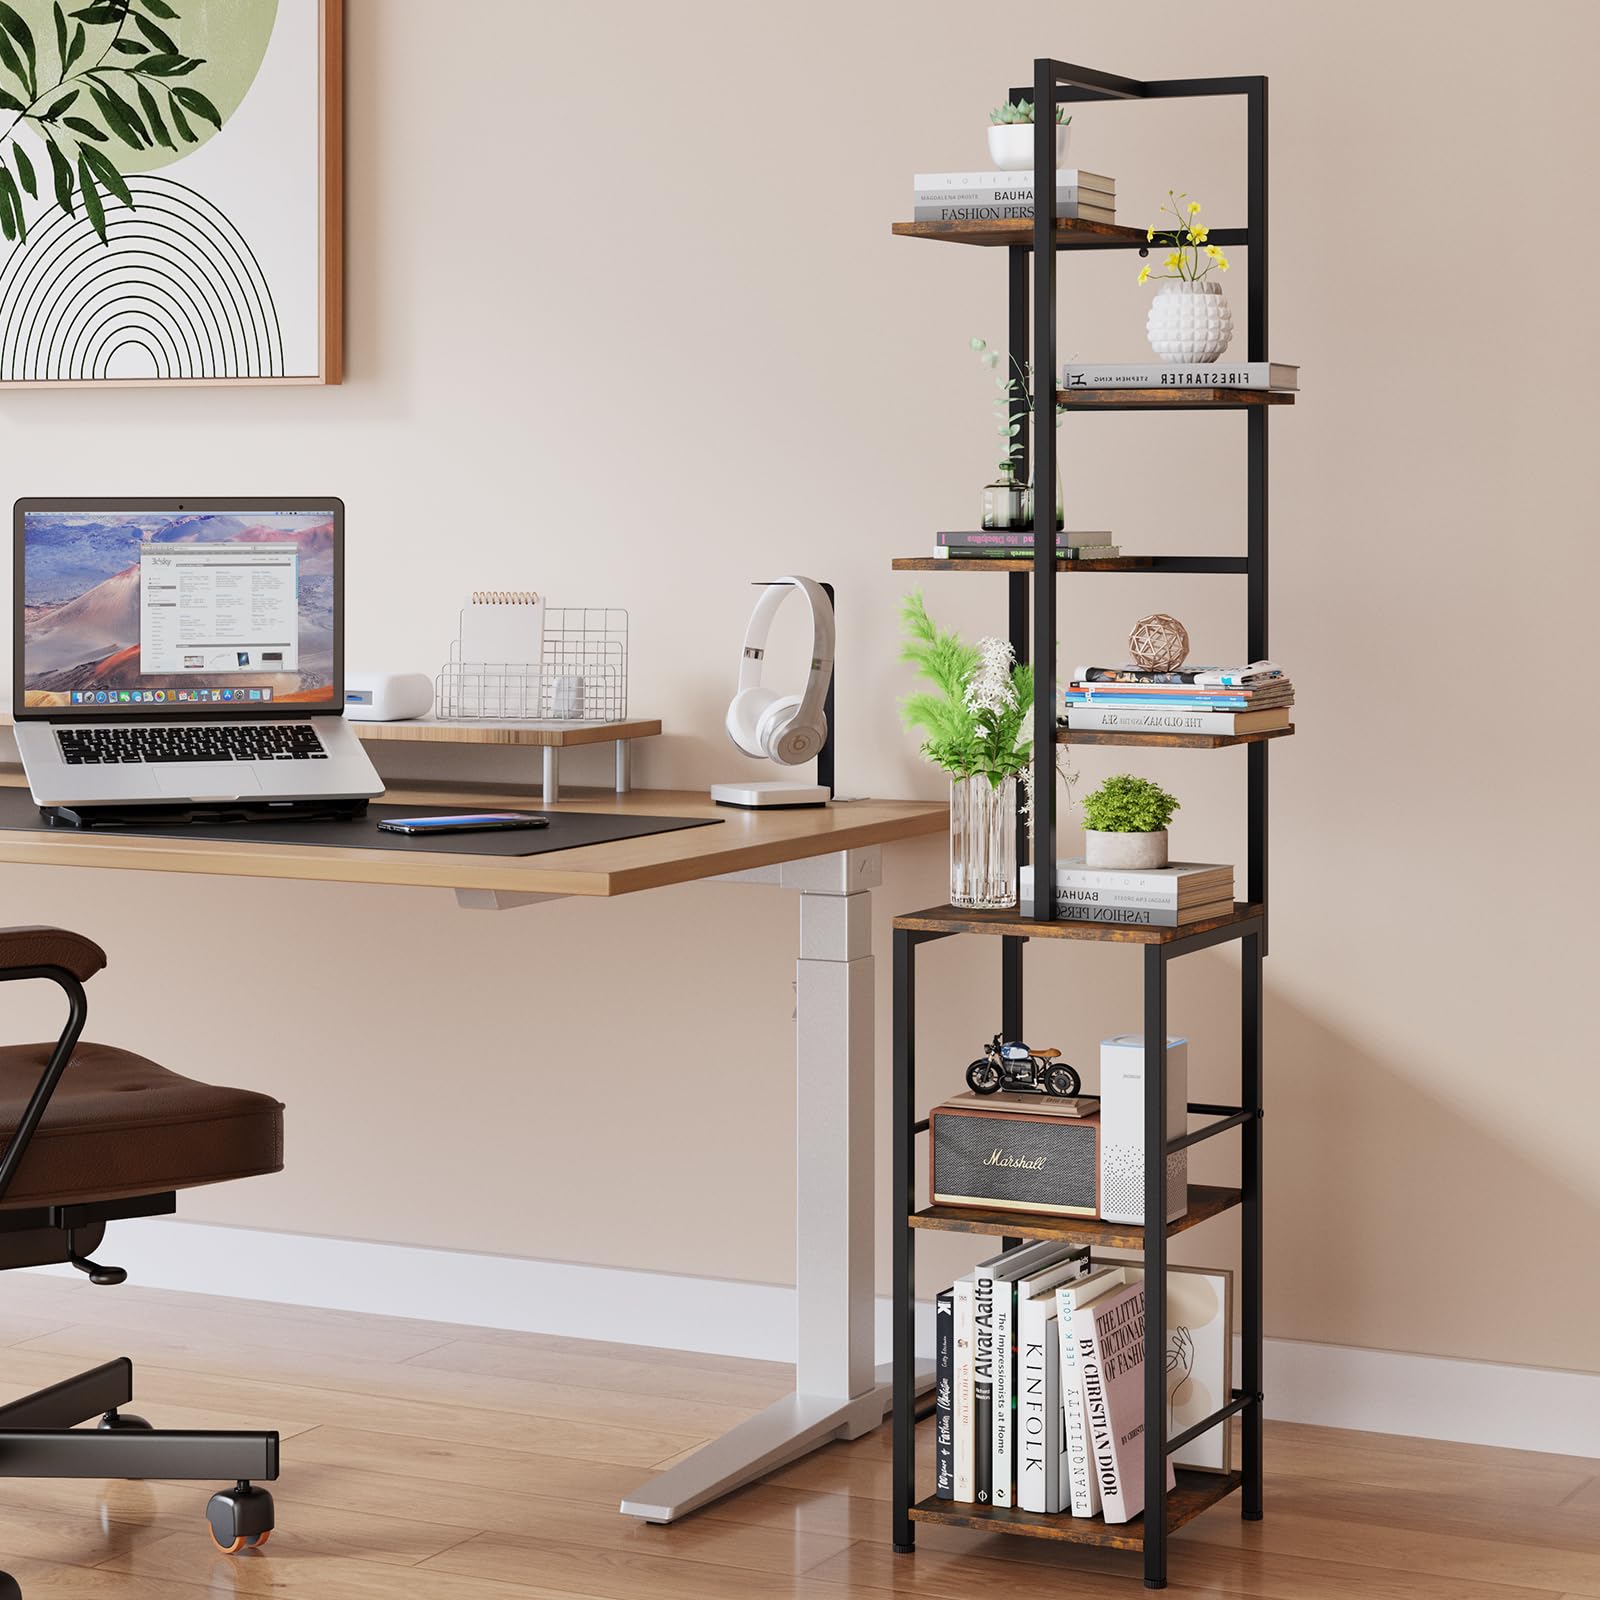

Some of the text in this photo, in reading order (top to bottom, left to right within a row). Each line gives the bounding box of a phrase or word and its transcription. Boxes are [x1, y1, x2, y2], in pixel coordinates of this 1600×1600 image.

[994, 190, 1034, 201] BAUHA
[941, 206, 1035, 221] FASHION PERS
[983, 1148, 1047, 1171] Marshall
[1062, 1292, 1071, 1322] COLE
[1095, 1310, 1114, 1337] THE
[1100, 1316, 1145, 1361] DICTIONAR
[1066, 1346, 1075, 1367] LEE
[1104, 1358, 1116, 1383] OF
[996, 1313, 1006, 1454] The Impressionists at Home
[1026, 1343, 1043, 1472] KINFOLK
[1079, 1339, 1118, 1496] BY CHRISTIAN DIOR
[938, 1415, 951, 1445] Fashion
[1067, 1389, 1087, 1509] TRANQUILITY
